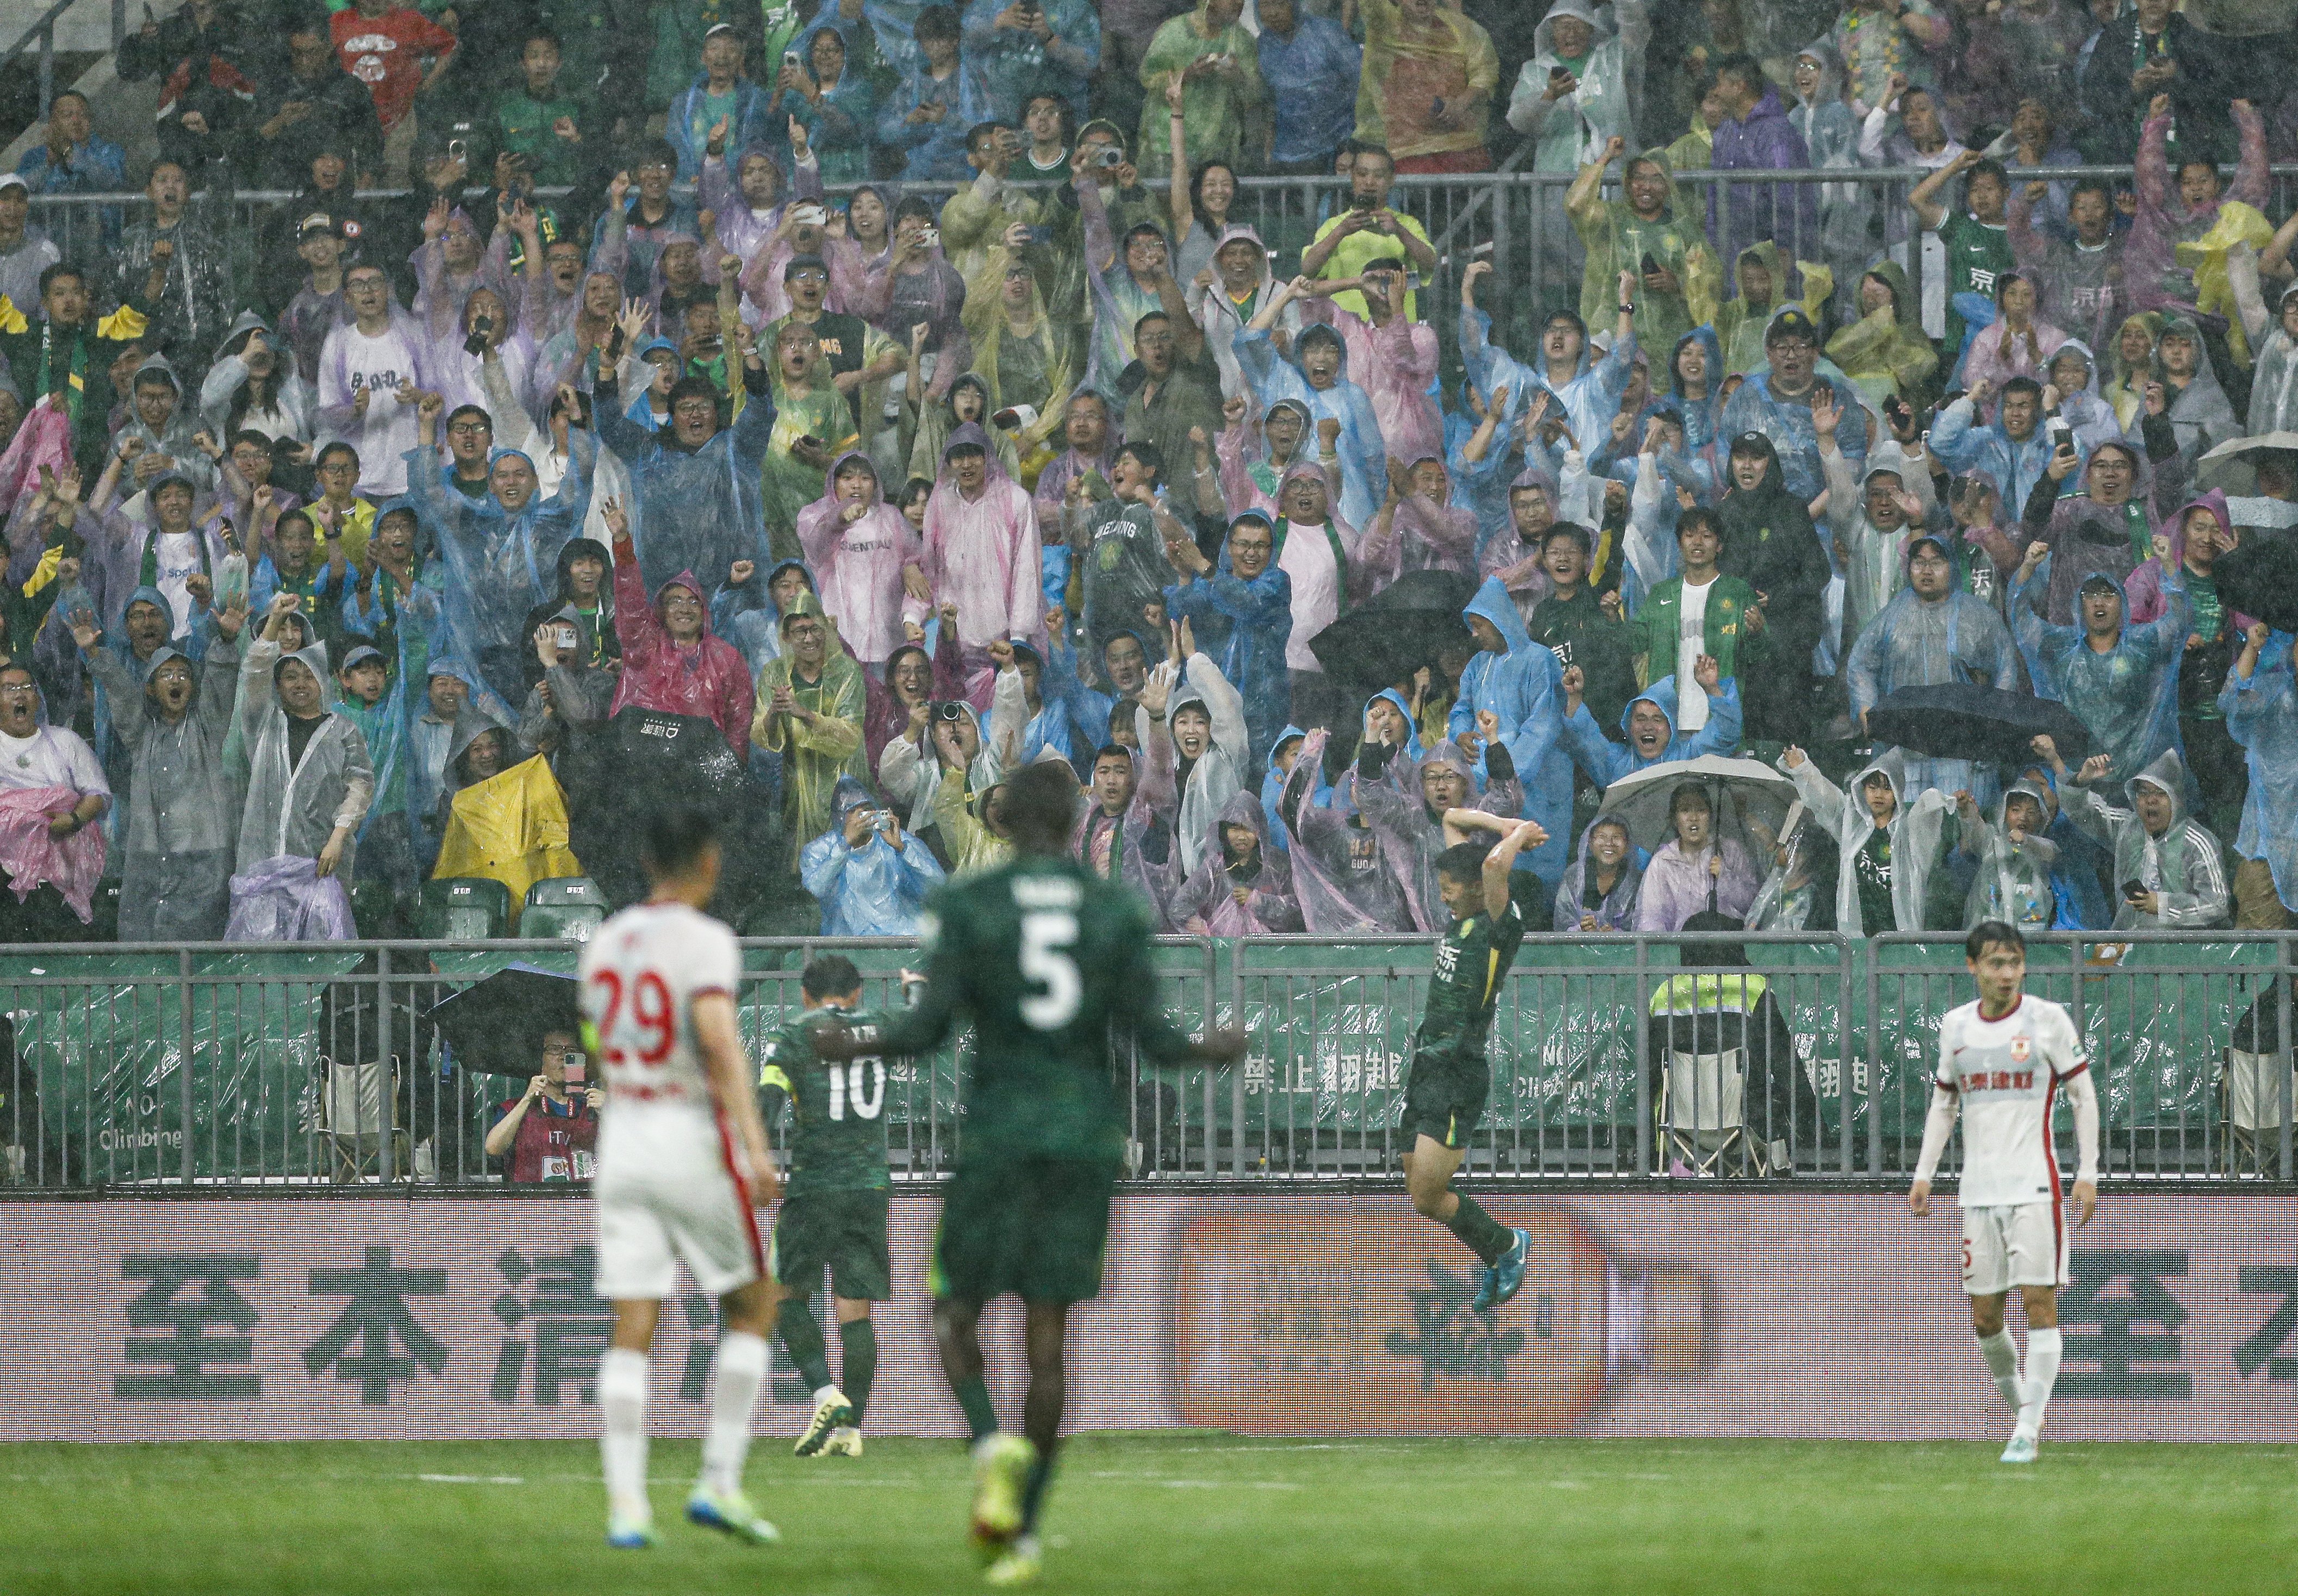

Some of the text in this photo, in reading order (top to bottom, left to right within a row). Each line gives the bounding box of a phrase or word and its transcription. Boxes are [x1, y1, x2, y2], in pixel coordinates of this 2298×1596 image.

[1969, 266, 1996, 293] 京
[1018, 913, 1083, 1031] 5
[593, 969, 676, 1064] 29
[823, 1056, 886, 1121] 10
[1244, 1052, 1403, 1095] 禁止翻越
[99, 1125, 183, 1151] Climbing
